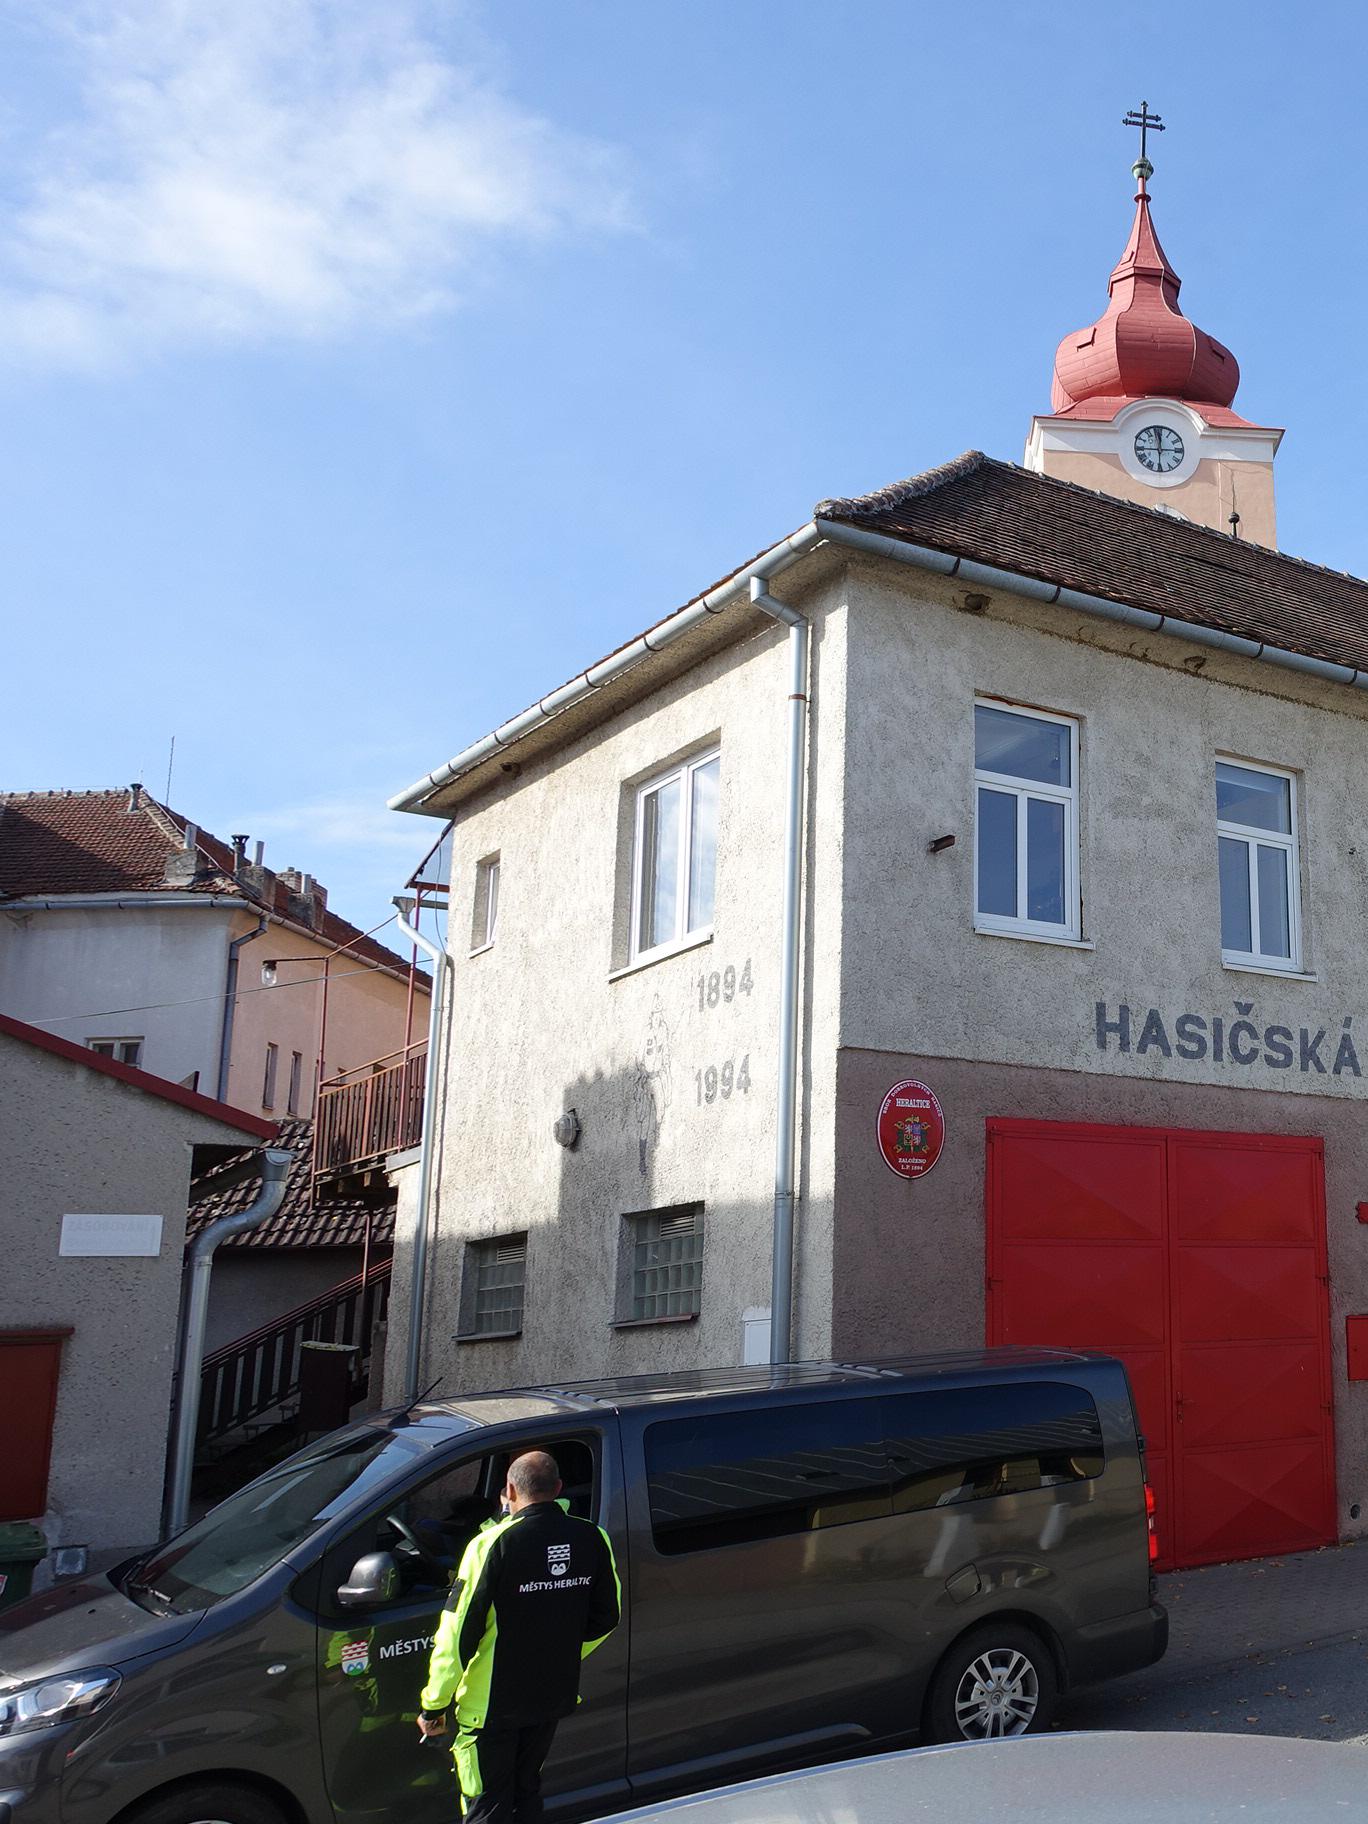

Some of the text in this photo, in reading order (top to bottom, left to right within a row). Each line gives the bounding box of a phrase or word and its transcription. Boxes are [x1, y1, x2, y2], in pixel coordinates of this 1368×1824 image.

[697, 957, 754, 1012] 1894
[1095, 1001, 1362, 1077] HASIČSKÁ
[695, 1053, 751, 1107] 1994
[896, 1098, 931, 1109] HERALTICE
[519, 1576, 592, 1592] MĚSTYS HERALTIC
